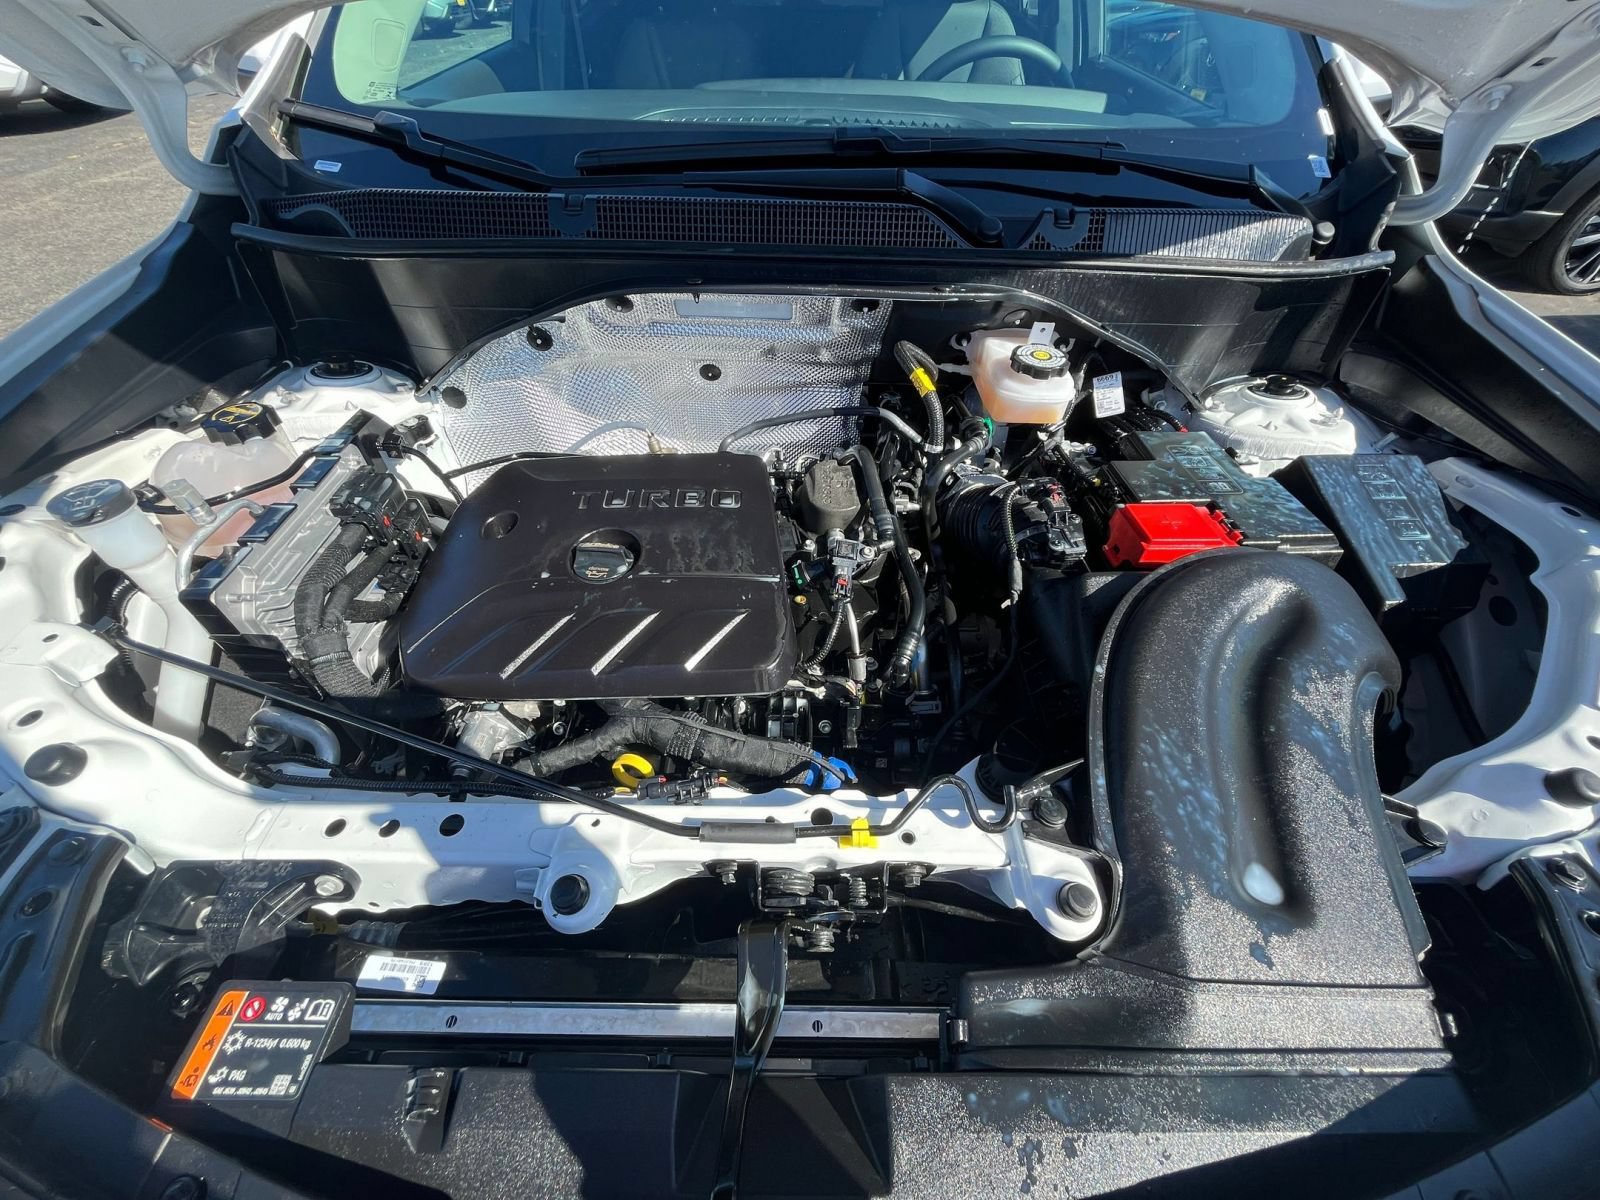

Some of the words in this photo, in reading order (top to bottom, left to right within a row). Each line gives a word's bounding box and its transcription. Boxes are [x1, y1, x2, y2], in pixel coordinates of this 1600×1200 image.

[572, 488, 743, 510] TURBO
[264, 1013, 284, 1021] AUTO
[300, 1038, 312, 1050] kg
[228, 1069, 248, 1081] PAG
